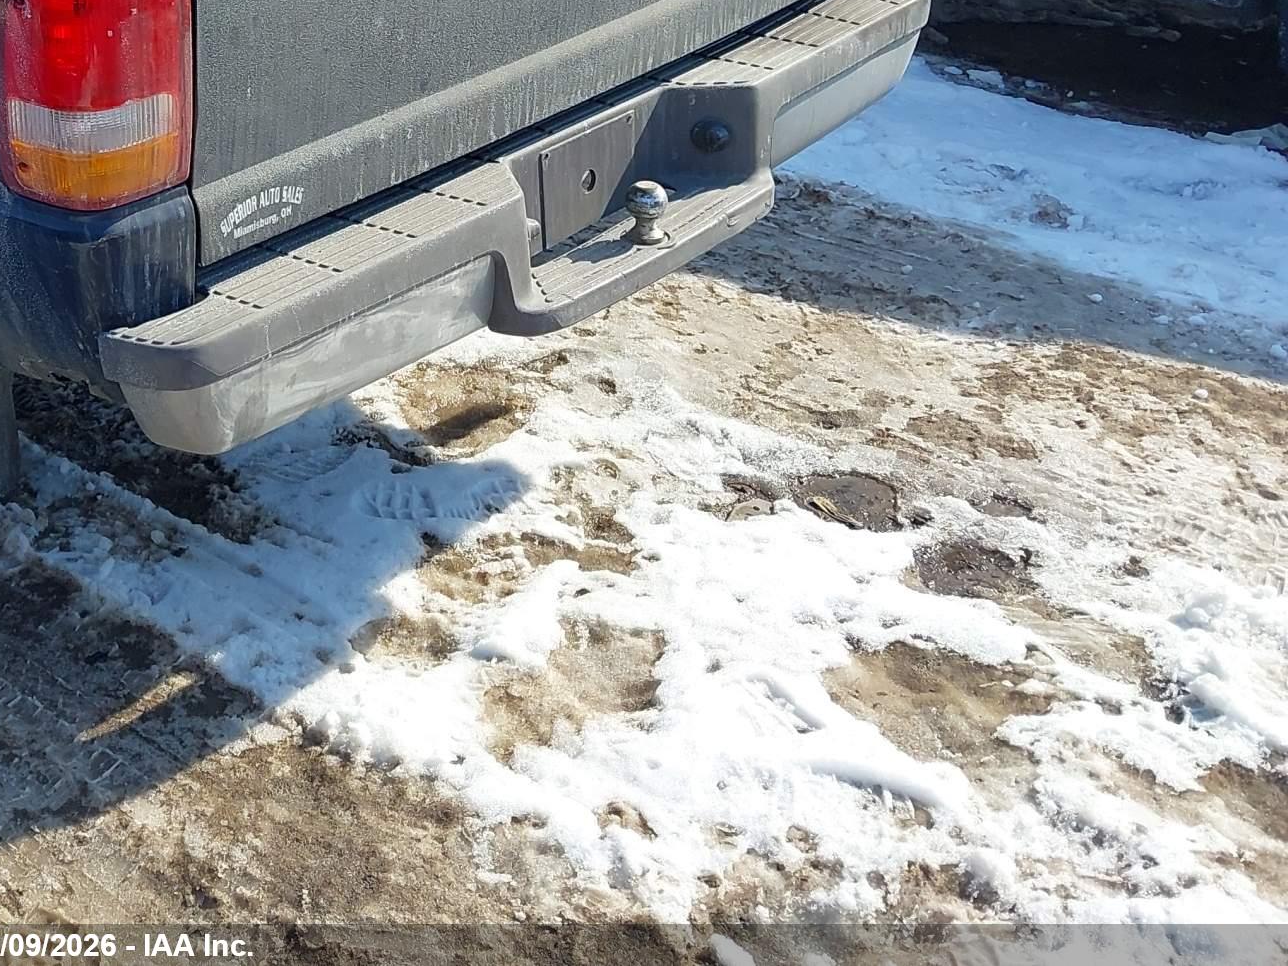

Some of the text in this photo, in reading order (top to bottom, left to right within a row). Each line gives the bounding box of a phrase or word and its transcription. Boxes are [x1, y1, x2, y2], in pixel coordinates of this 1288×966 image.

[220, 186, 304, 238] SUPERIOR AUTO SALES
[280, 205, 293, 218] OH
